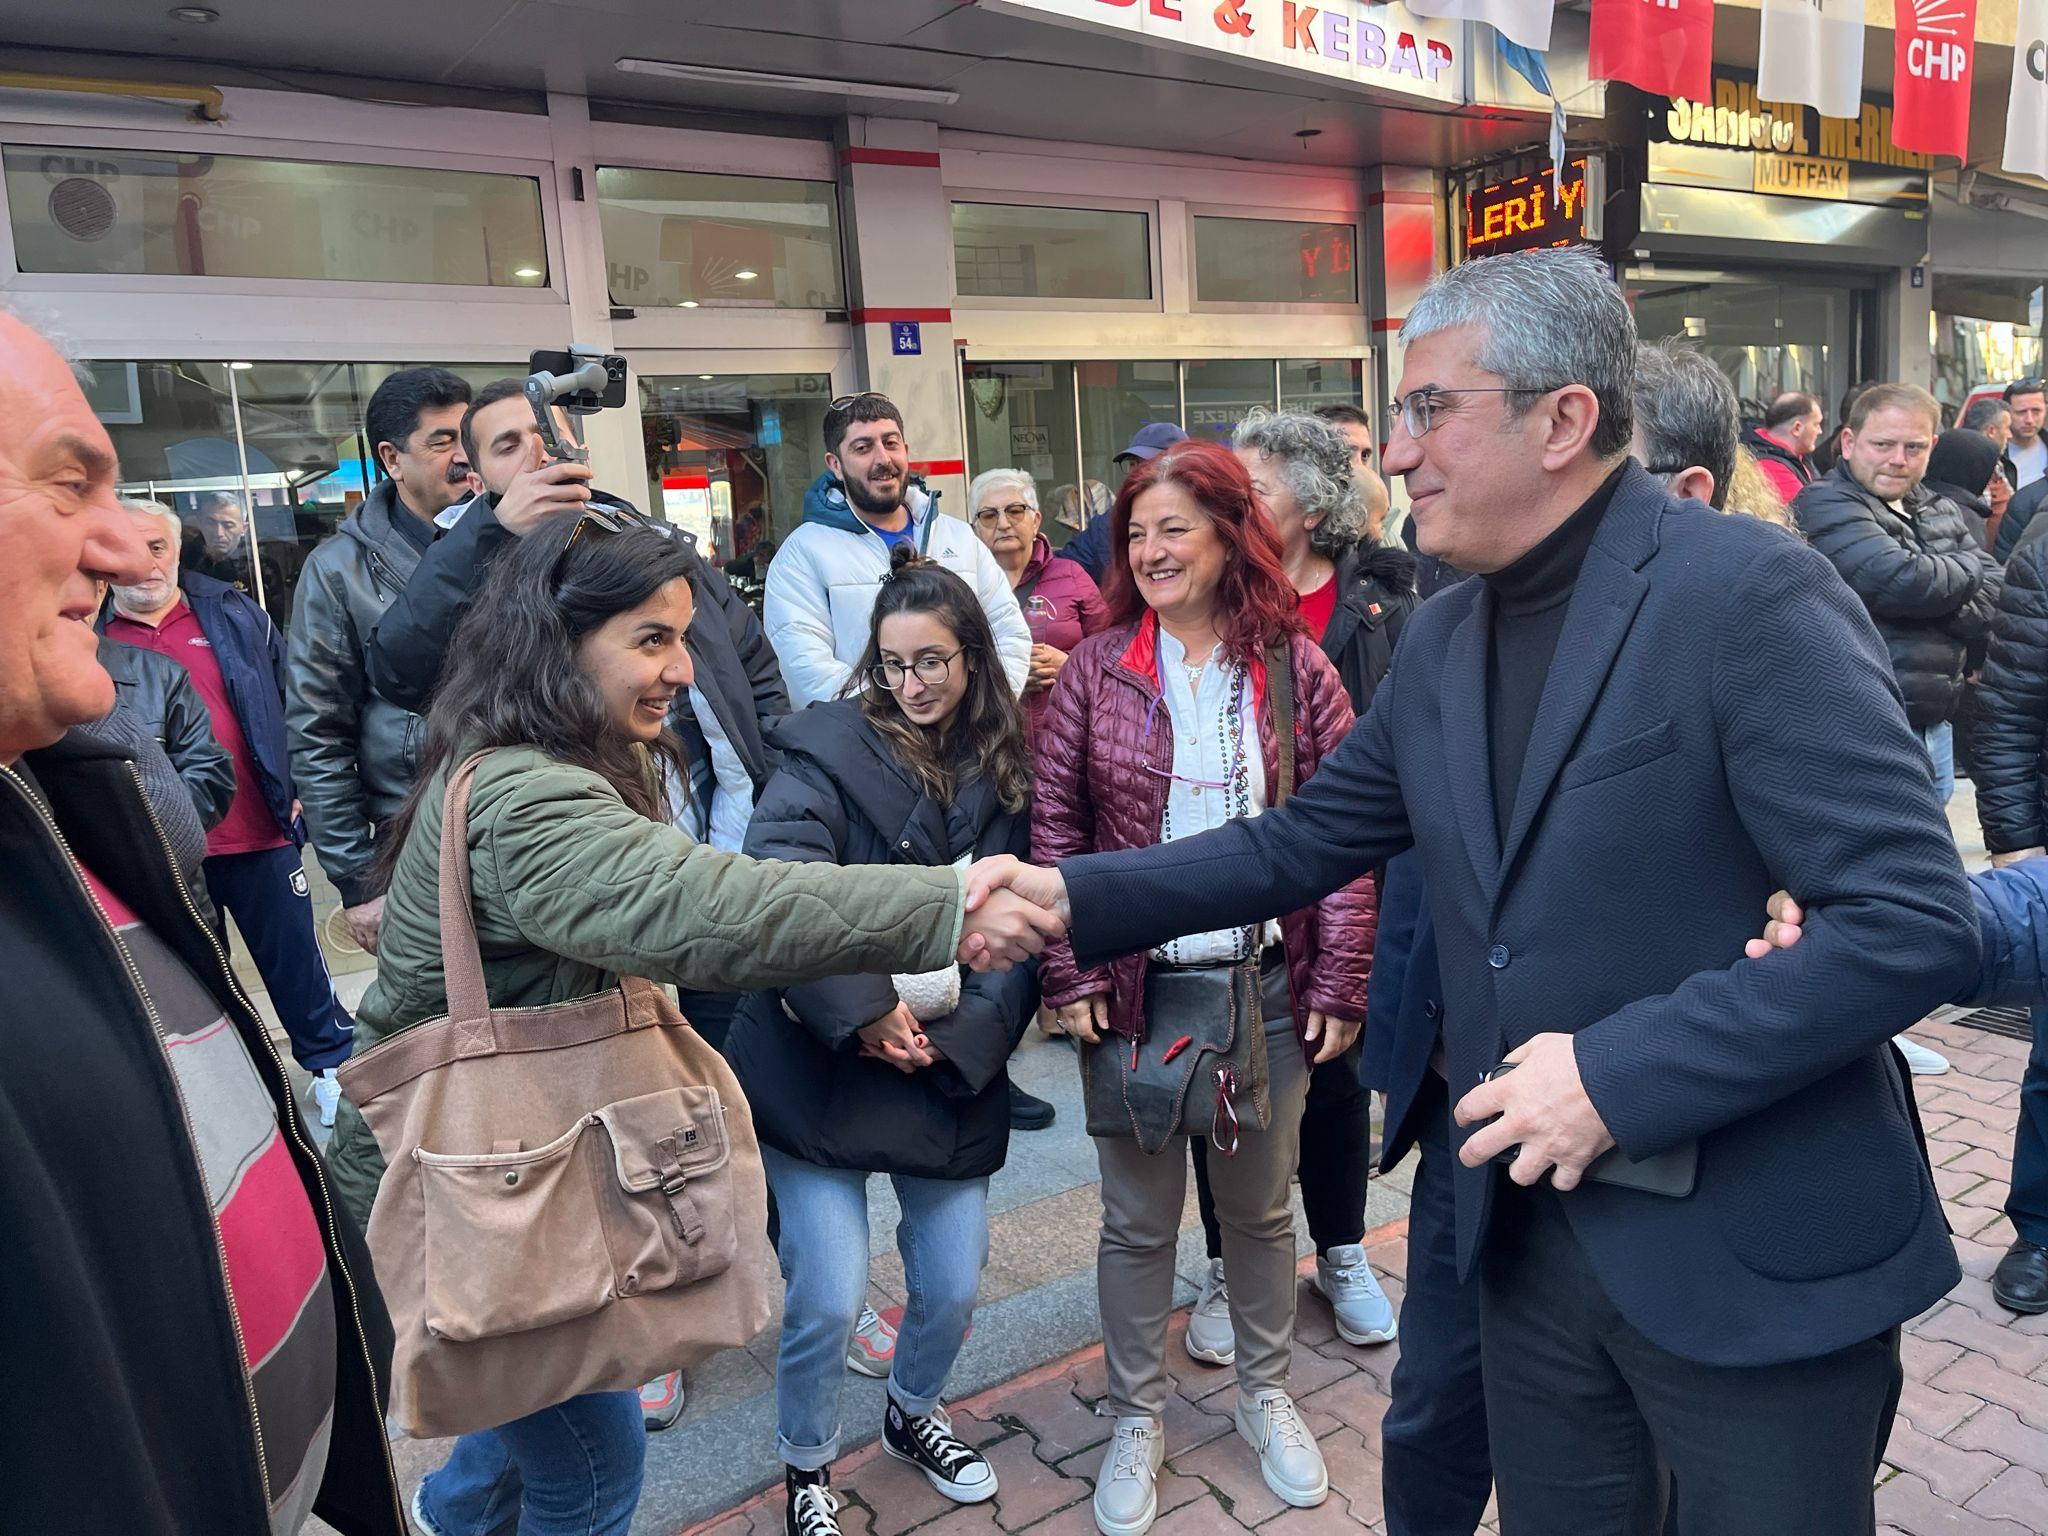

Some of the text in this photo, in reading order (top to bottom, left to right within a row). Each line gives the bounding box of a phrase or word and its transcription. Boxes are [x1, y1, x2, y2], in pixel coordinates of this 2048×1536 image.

[1282, 1, 1454, 83] KEBAP
[1907, 37, 1966, 82] CHP
[1819, 101, 1934, 171] MERM
[1759, 159, 1844, 190] MUTFAK
[609, 262, 650, 292] HP
[899, 336, 912, 350] 54
